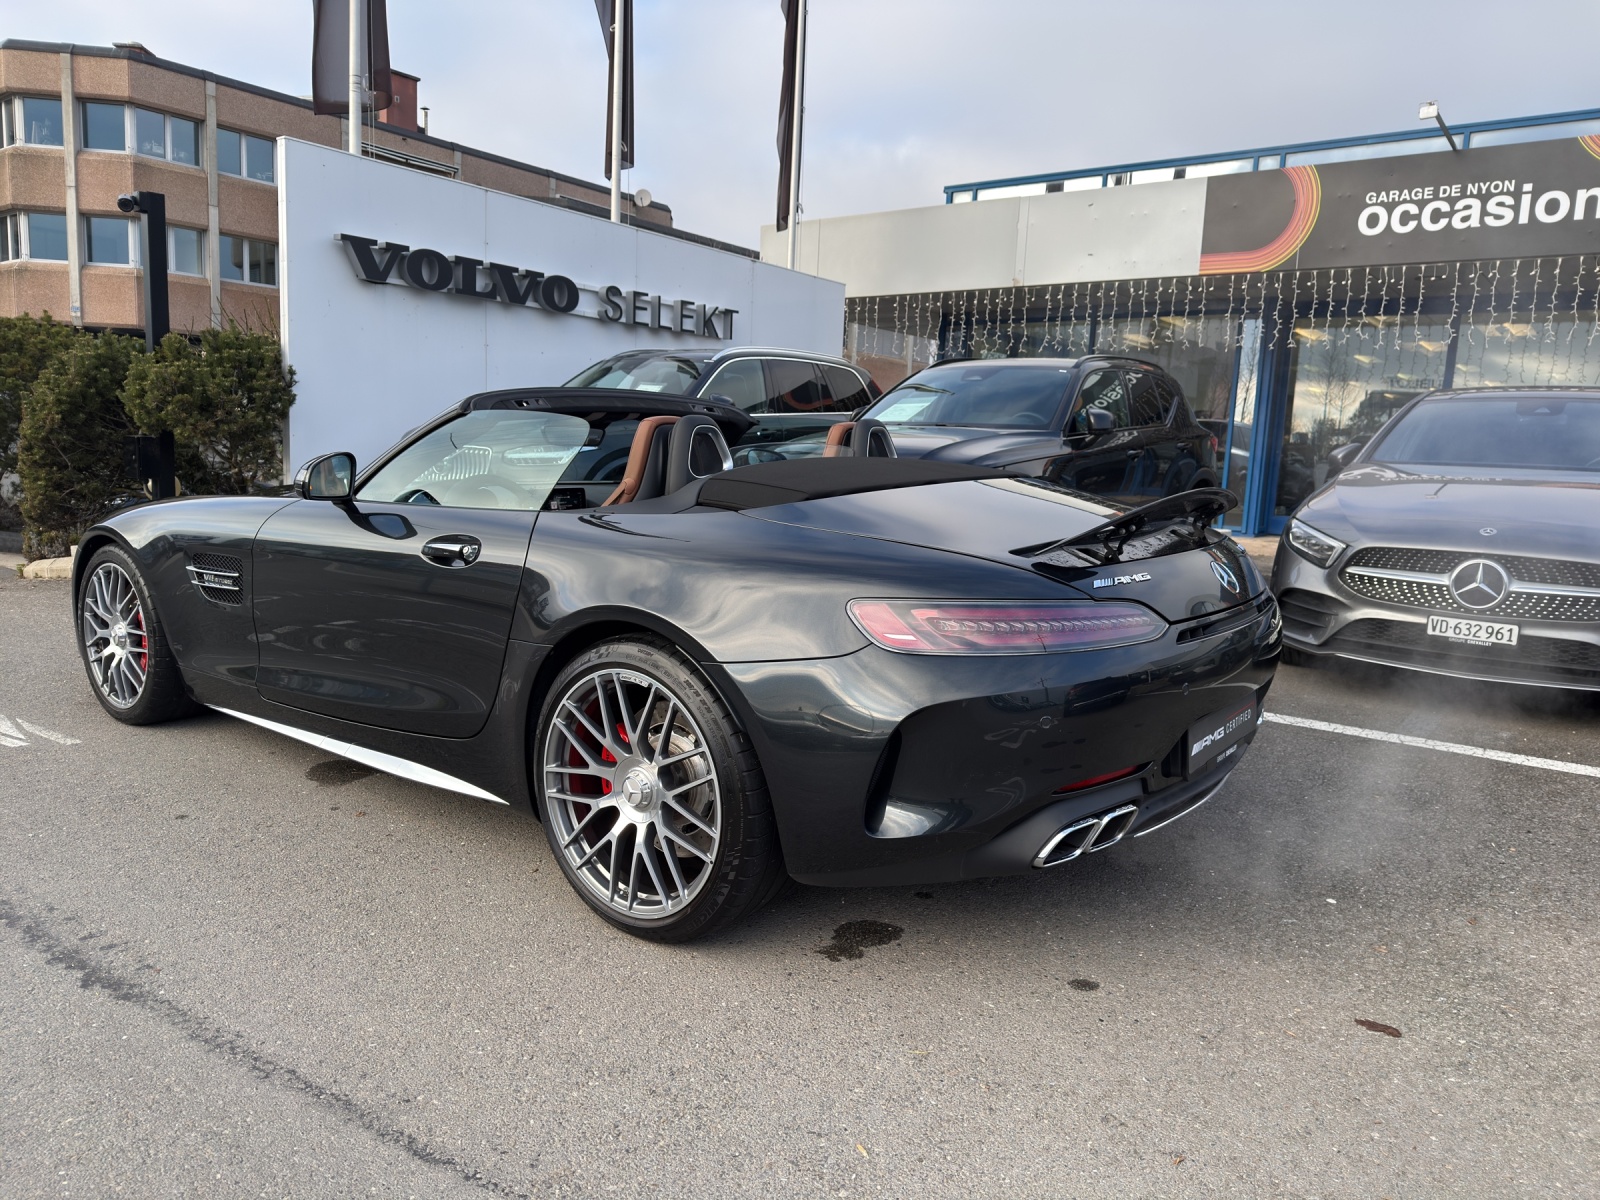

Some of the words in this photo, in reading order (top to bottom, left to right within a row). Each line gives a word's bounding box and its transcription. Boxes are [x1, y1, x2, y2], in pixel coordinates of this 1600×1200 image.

[1357, 183, 1600, 236] occasion
[1365, 187, 1434, 204] GARAGE
[1439, 184, 1462, 198] DE
[1467, 180, 1515, 196] NYON
[336, 233, 580, 314] VOLVO
[598, 285, 739, 340] SELEKT
[1225, 708, 1251, 734] CERTIFIED
